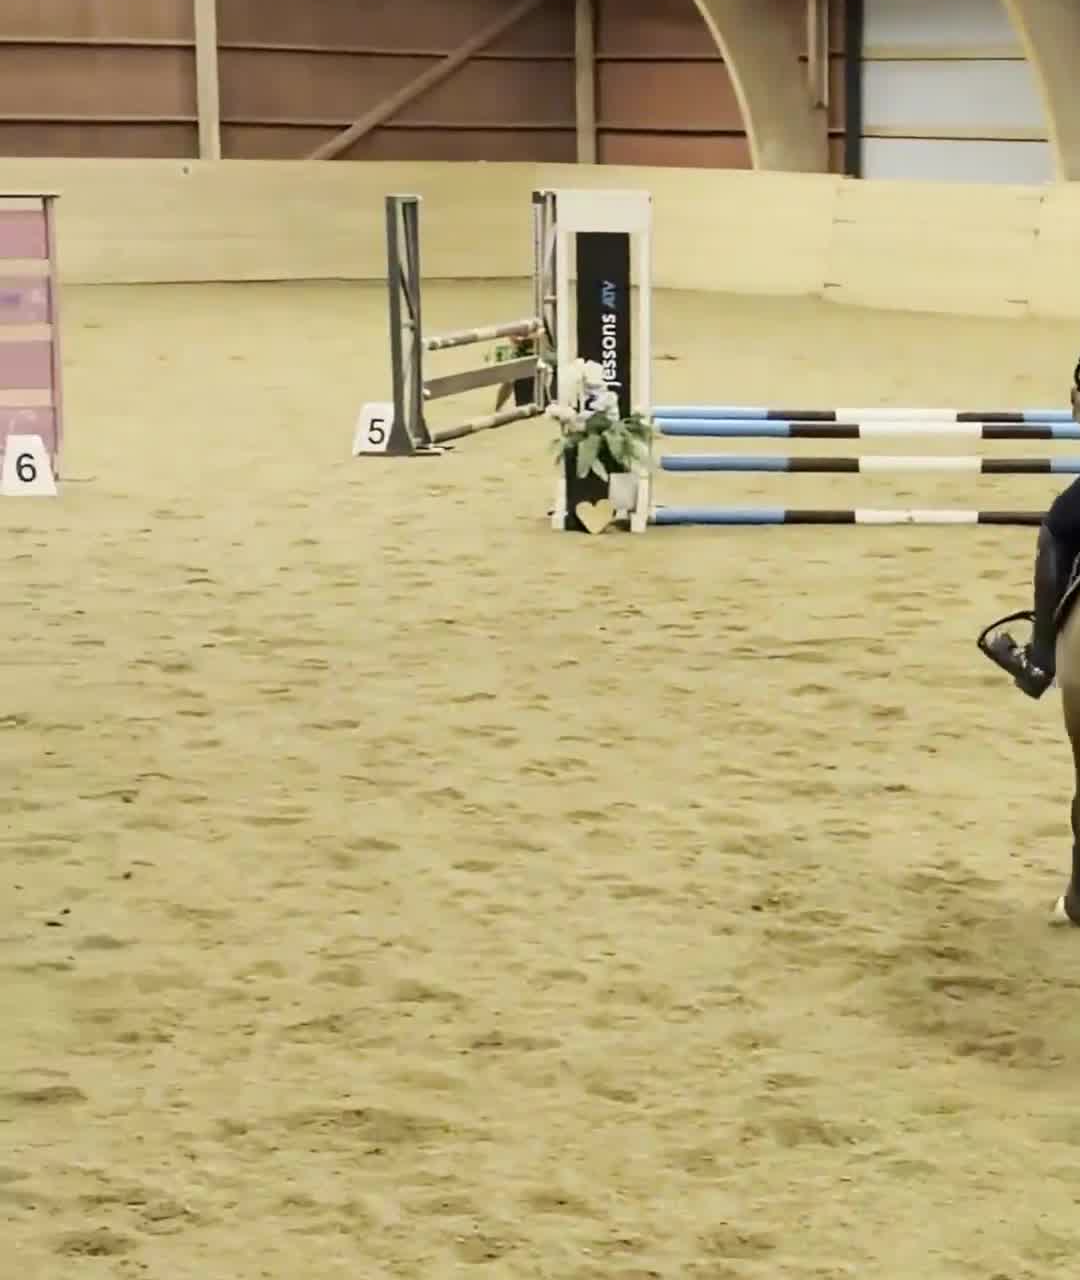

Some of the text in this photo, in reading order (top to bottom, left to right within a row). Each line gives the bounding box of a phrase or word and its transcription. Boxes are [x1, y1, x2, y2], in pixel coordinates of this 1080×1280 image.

[602, 279, 617, 308] ATV
[368, 418, 385, 445] 5
[16, 453, 37, 482] 6
